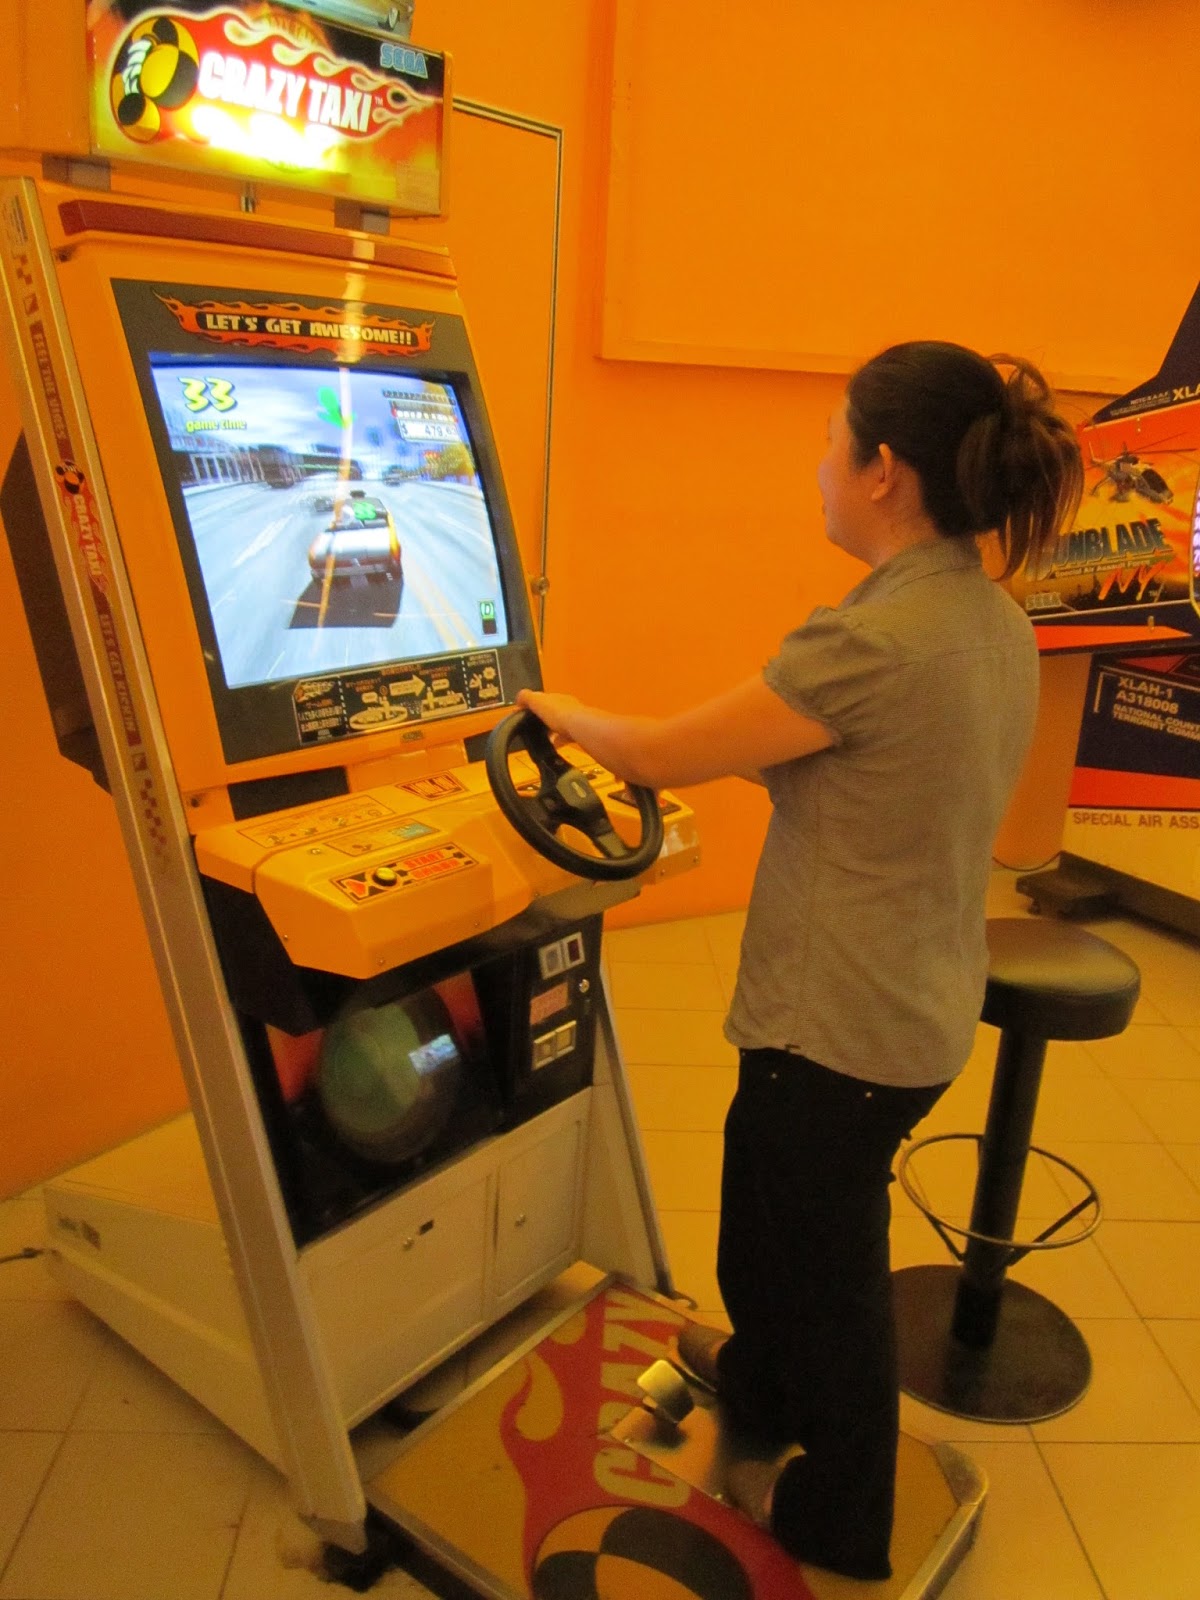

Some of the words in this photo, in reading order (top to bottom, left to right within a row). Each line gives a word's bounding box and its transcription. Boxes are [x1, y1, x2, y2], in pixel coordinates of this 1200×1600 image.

[380, 42, 428, 79] SEGA
[198, 50, 306, 118] CRAZY
[309, 80, 372, 132] TAXI
[206, 313, 258, 331] LET'S
[265, 317, 302, 335] GET
[310, 322, 412, 345] AWESOME!!
[177, 376, 237, 413] 33
[186, 420, 219, 433] game
[74, 494, 94, 540] CRAZY
[1118, 676, 1173, 699] XLAH-1
[1113, 703, 1162, 721] NATIONAL
[1116, 690, 1179, 714] A318008
[1073, 812, 1131, 827] SPECIAL
[1138, 814, 1162, 828] AIR
